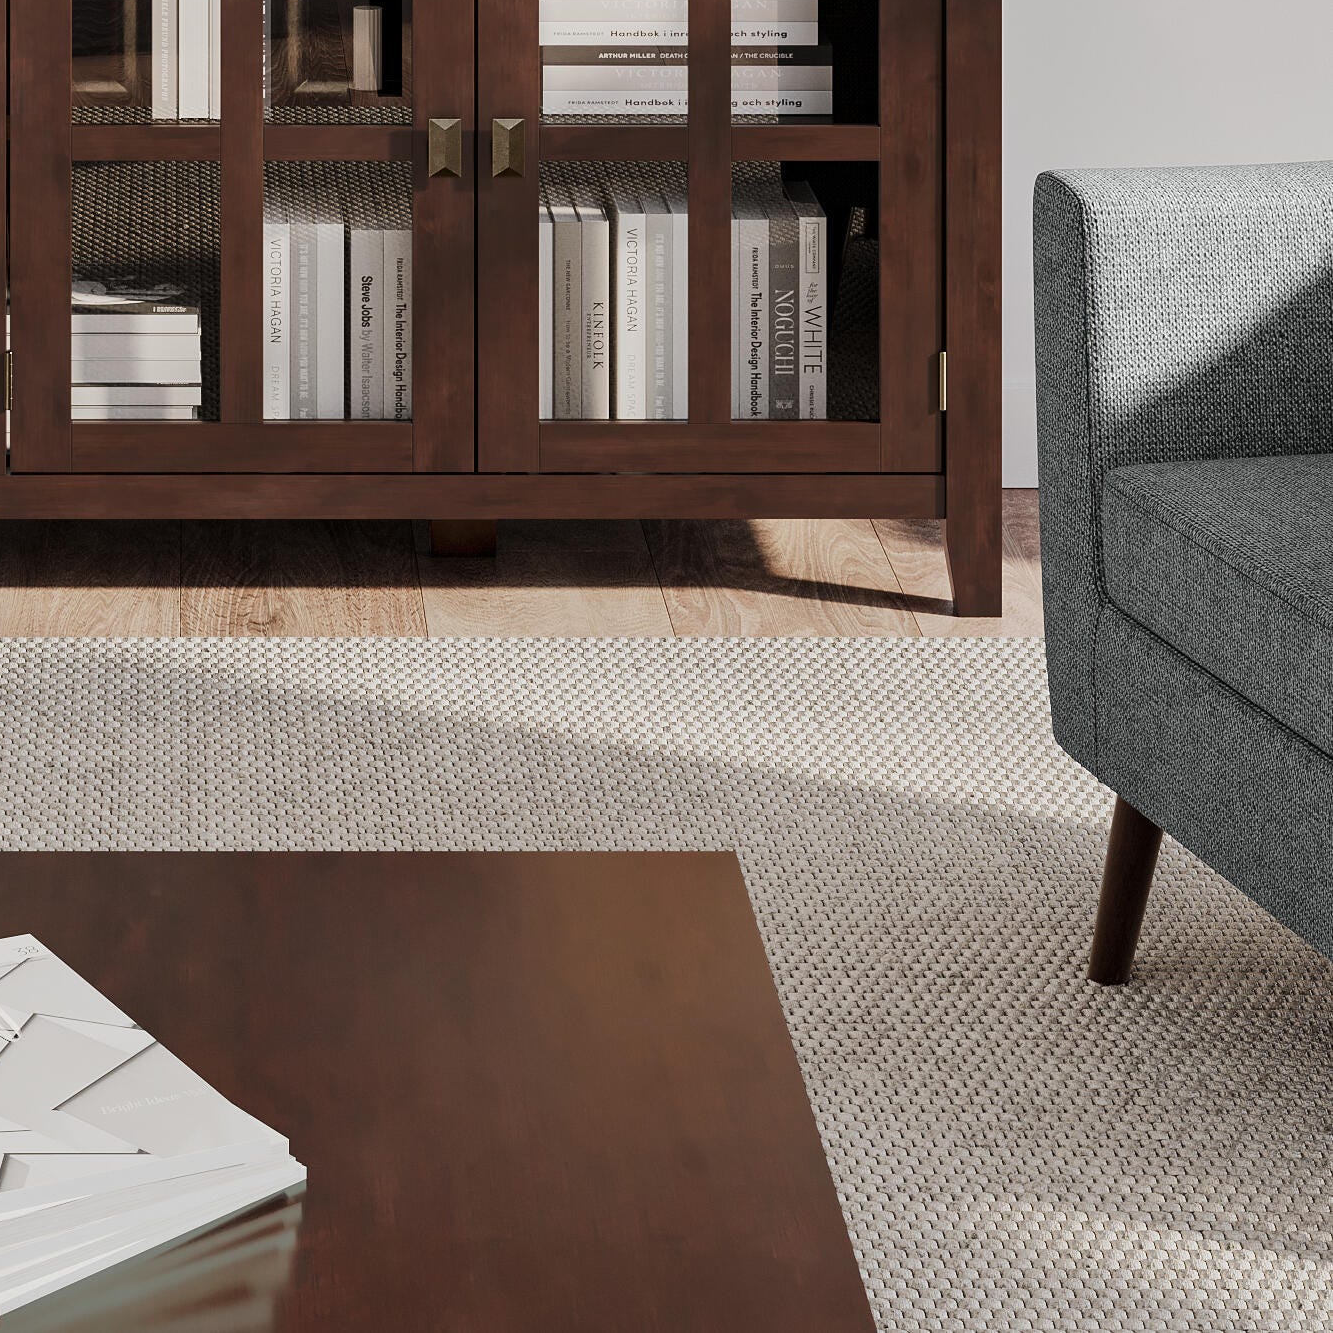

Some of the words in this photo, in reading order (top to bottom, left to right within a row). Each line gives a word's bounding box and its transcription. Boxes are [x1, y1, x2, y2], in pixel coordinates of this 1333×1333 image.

[751, 30, 788, 39] styling
[765, 99, 802, 108] styling
[271, 239, 281, 296] VICTORIA
[626, 228, 638, 285] VICTORIA
[362, 276, 373, 303] Steve
[751, 292, 762, 307] The
[271, 301, 282, 343] HAGAN
[362, 304, 373, 327] Jobs
[396, 304, 406, 318] The
[626, 290, 637, 332] HAGAN
[751, 309, 762, 339] Interior
[359, 330, 372, 341] by
[396, 321, 406, 351] Interior
[593, 302, 604, 370] KINFOLK
[775, 289, 794, 375] NOGUCHI
[804, 306, 822, 373] WHITE
[362, 343, 373, 373] Walter
[393, 353, 406, 381] Design
[748, 342, 762, 370] Design
[395, 384, 406, 419] Handbo
[627, 394, 635, 417] SPAC
[750, 373, 762, 416] Handbook
